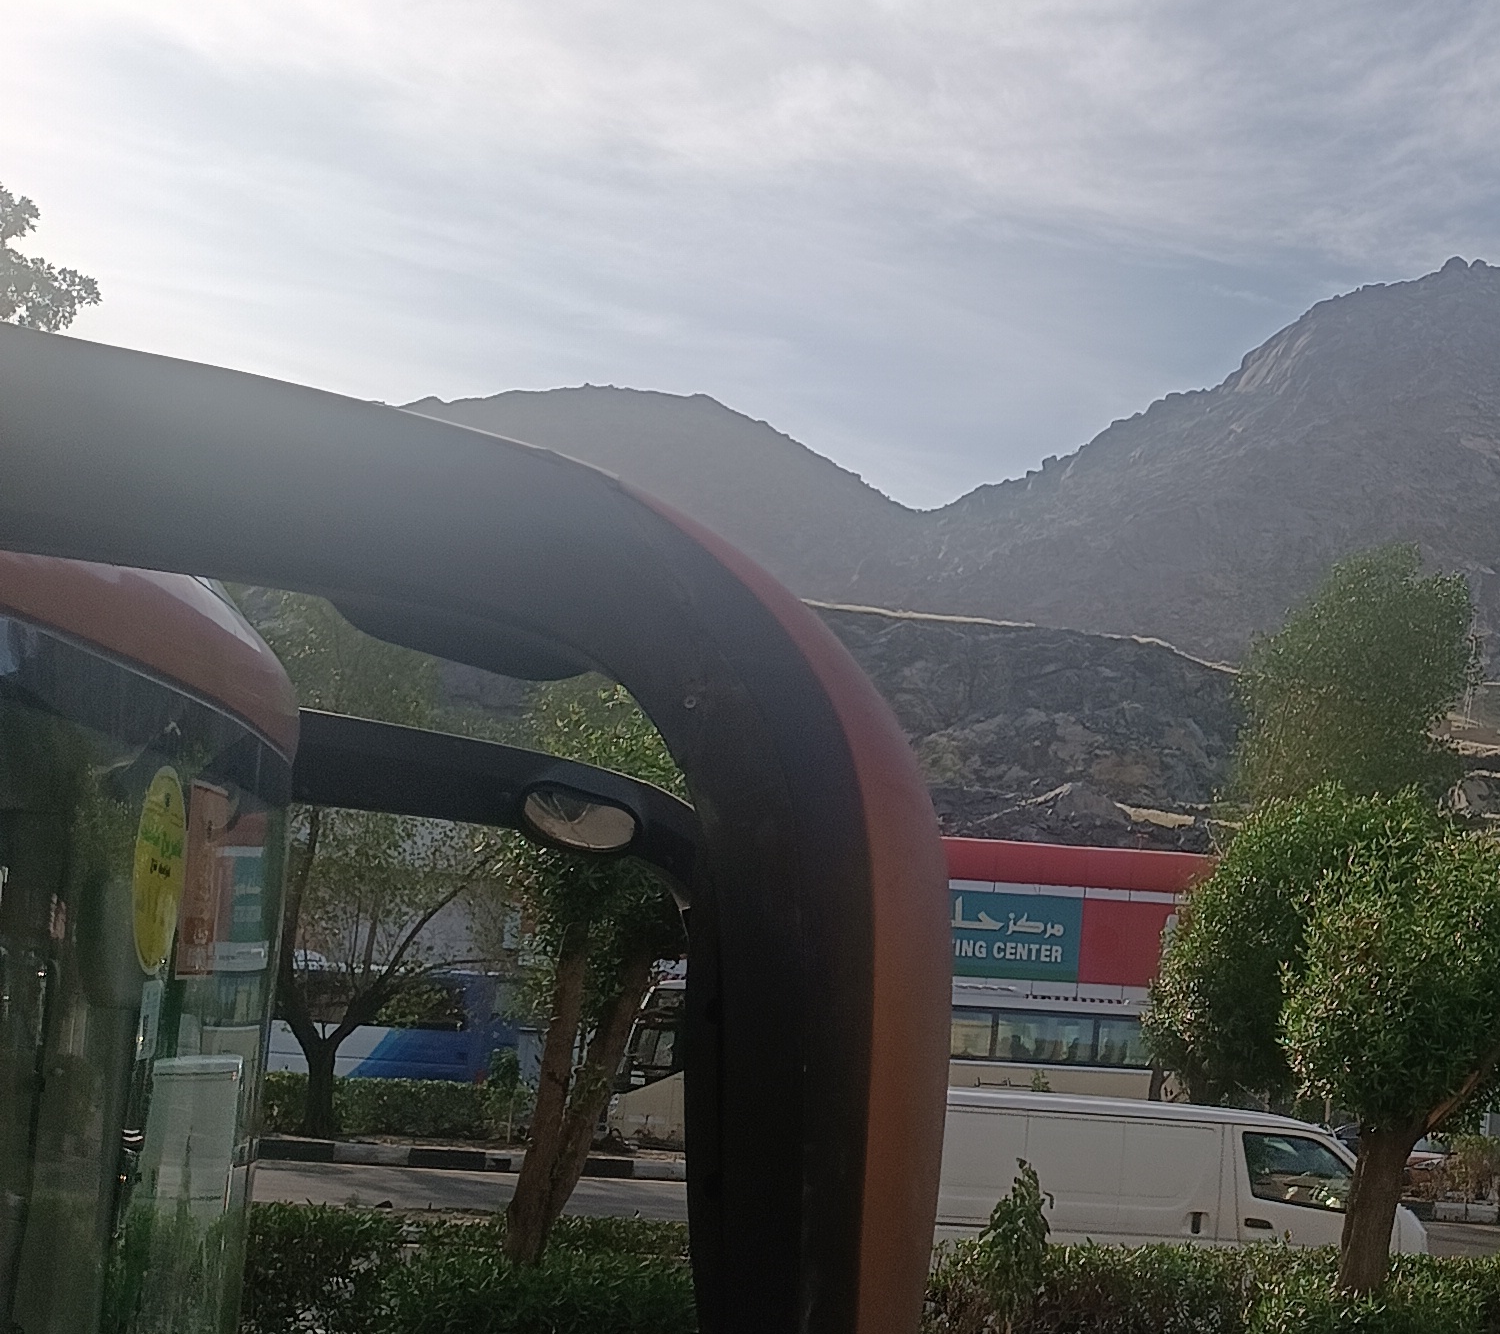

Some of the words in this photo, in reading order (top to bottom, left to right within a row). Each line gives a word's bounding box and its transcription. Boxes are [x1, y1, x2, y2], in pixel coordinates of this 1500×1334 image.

[1005, 912, 1064, 938] مركز
[951, 938, 987, 958] ING
[992, 941, 1062, 962] CENTER
